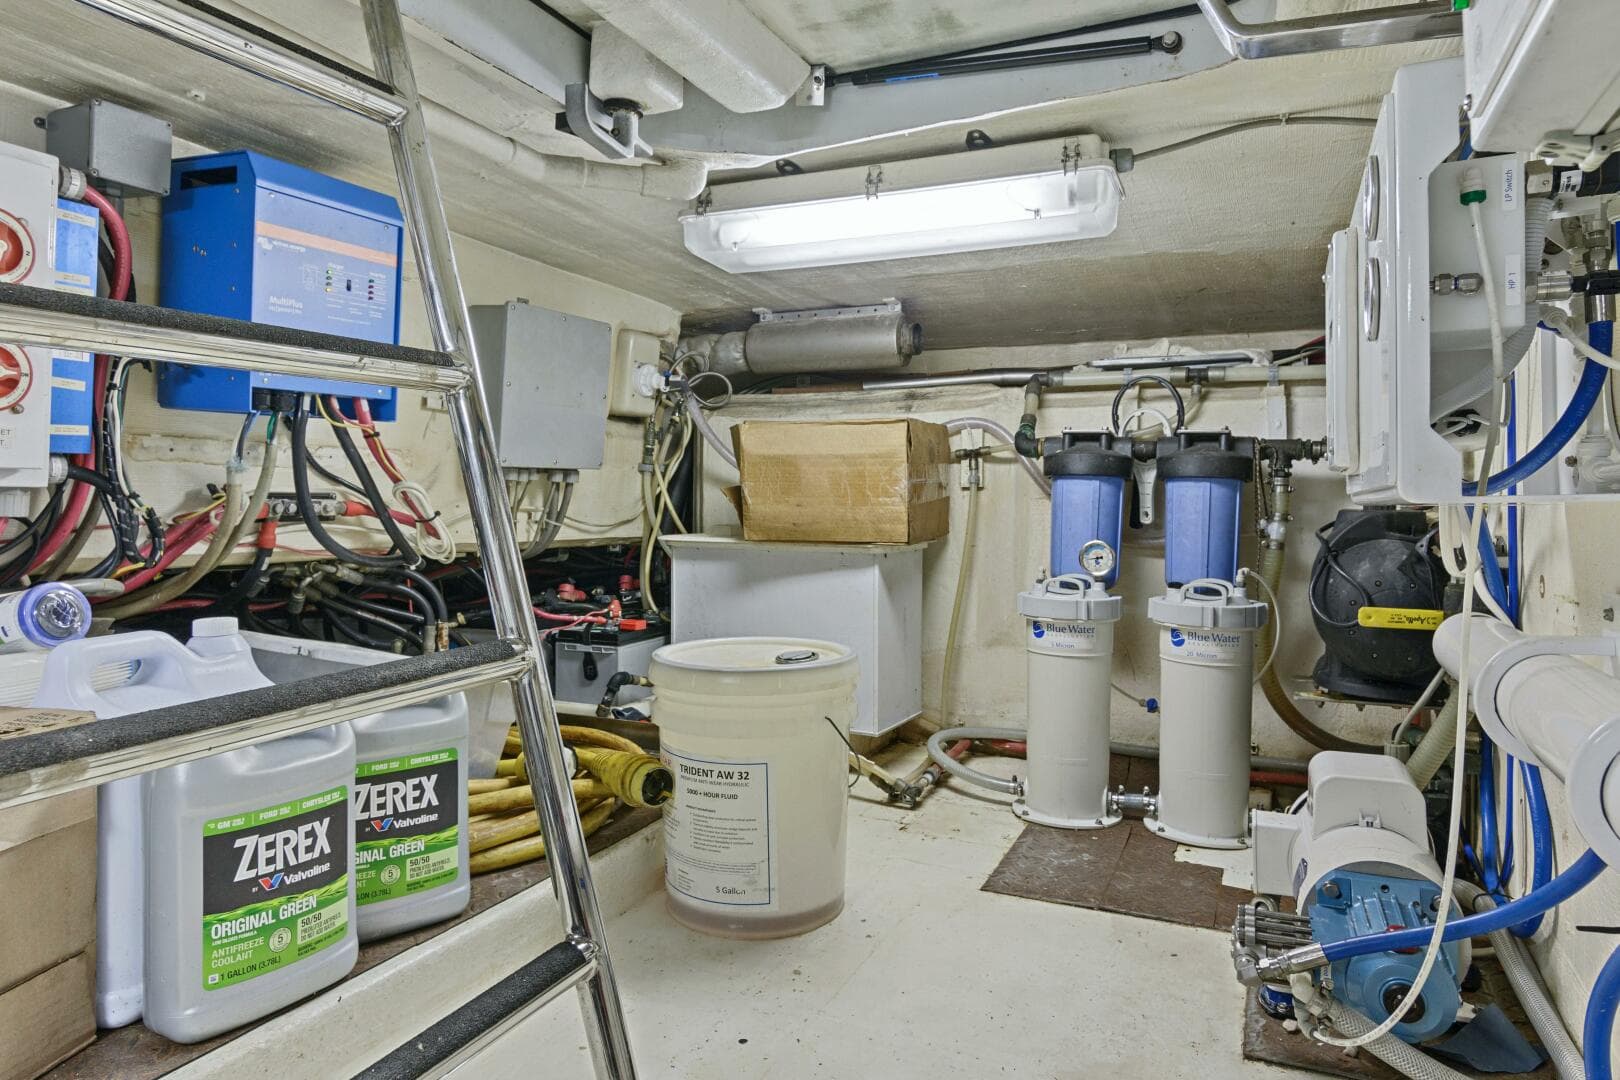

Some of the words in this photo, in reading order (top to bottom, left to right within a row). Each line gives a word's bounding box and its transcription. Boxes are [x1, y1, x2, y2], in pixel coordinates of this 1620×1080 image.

[1504, 169, 1513, 193] Switch
[1508, 280, 1517, 289] HP
[1046, 623, 1067, 634] Blue
[1067, 624, 1096, 635] Water
[1187, 631, 1210, 642] Blue
[1211, 633, 1241, 643] Water
[679, 763, 715, 779] TRIDENT
[716, 770, 735, 780] AW
[737, 771, 750, 781] 32
[354, 774, 440, 820] ZEREX
[392, 813, 439, 829] Valvoline
[233, 816, 331, 882] ZEREX
[389, 839, 425, 858] GREEN
[409, 855, 430, 867] 50/50
[283, 862, 331, 885] Valvoline
[387, 869, 393, 878] 5
[721, 886, 746, 895] Gallon
[211, 909, 276, 939] ORIGINAL
[279, 895, 317, 919] GREEN
[301, 912, 322, 928] 50/50
[211, 936, 265, 959] ANTIFREEZE
[278, 935, 284, 943] 5
[211, 950, 254, 968] COOLANT
[227, 963, 257, 979] GALLON
[258, 955, 282, 970] (3.78L)
